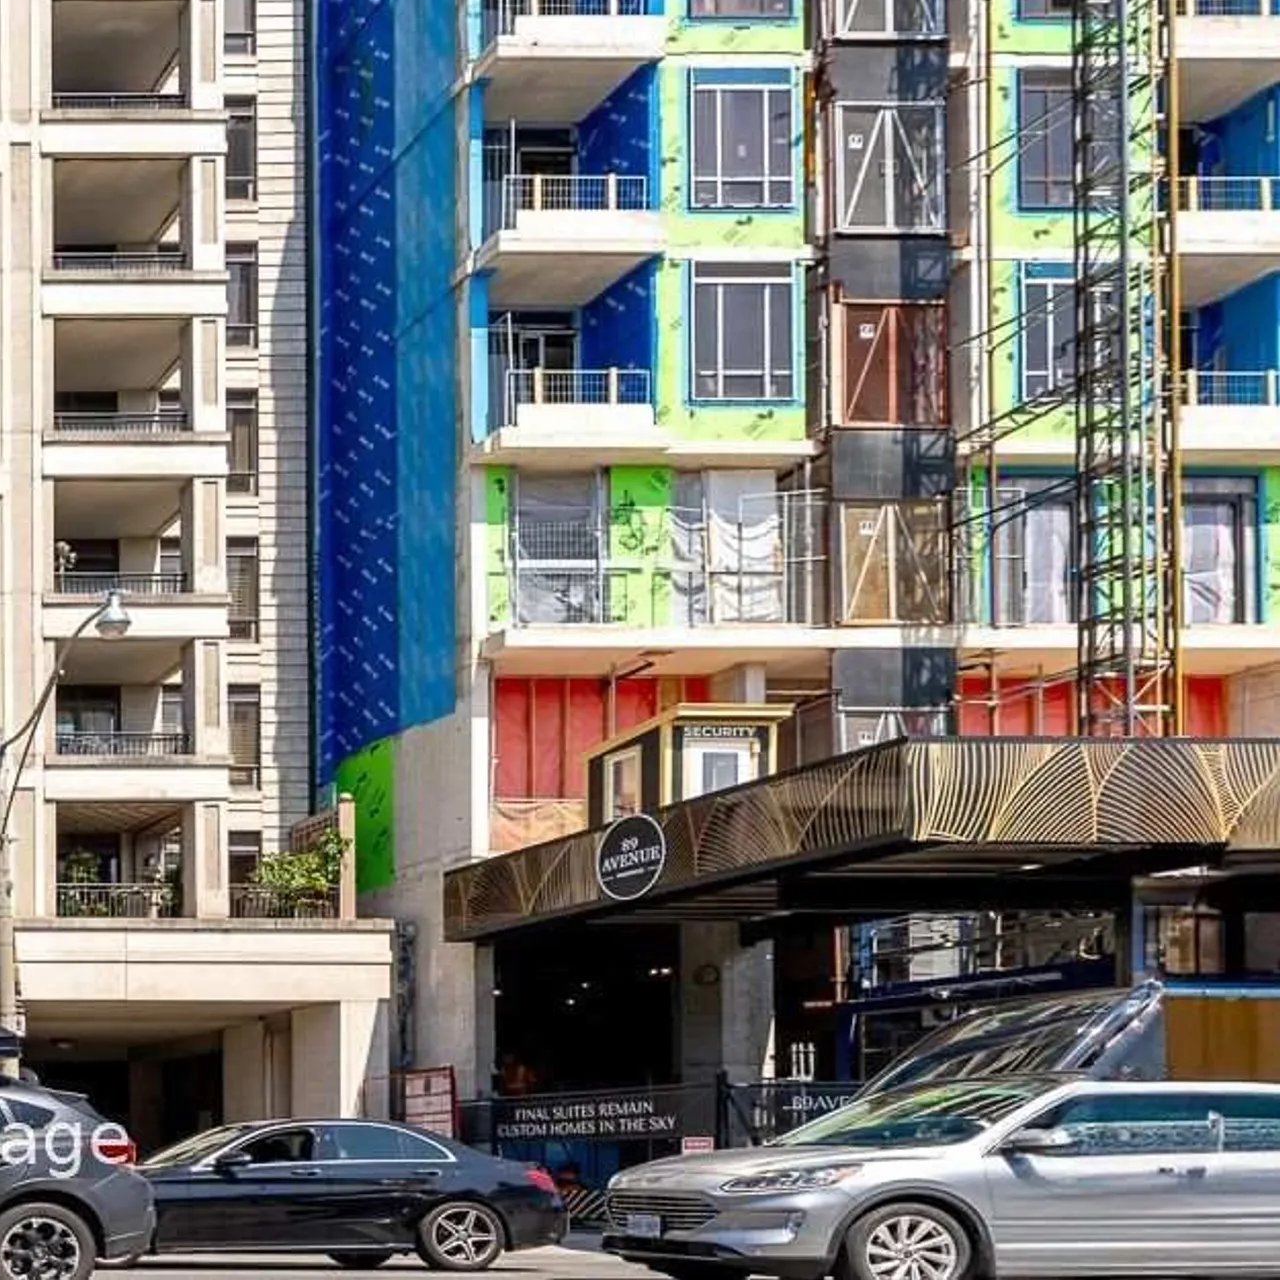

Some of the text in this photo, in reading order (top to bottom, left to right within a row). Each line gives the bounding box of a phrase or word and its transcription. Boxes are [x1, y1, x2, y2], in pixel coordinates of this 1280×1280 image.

[683, 726, 757, 738] SECURITY
[602, 844, 661, 873] AVENUE
[514, 1100, 654, 1121] FINAL SUITES REMAIN
[497, 1113, 677, 1138] CUSTOM HOMES IN THE SKY
